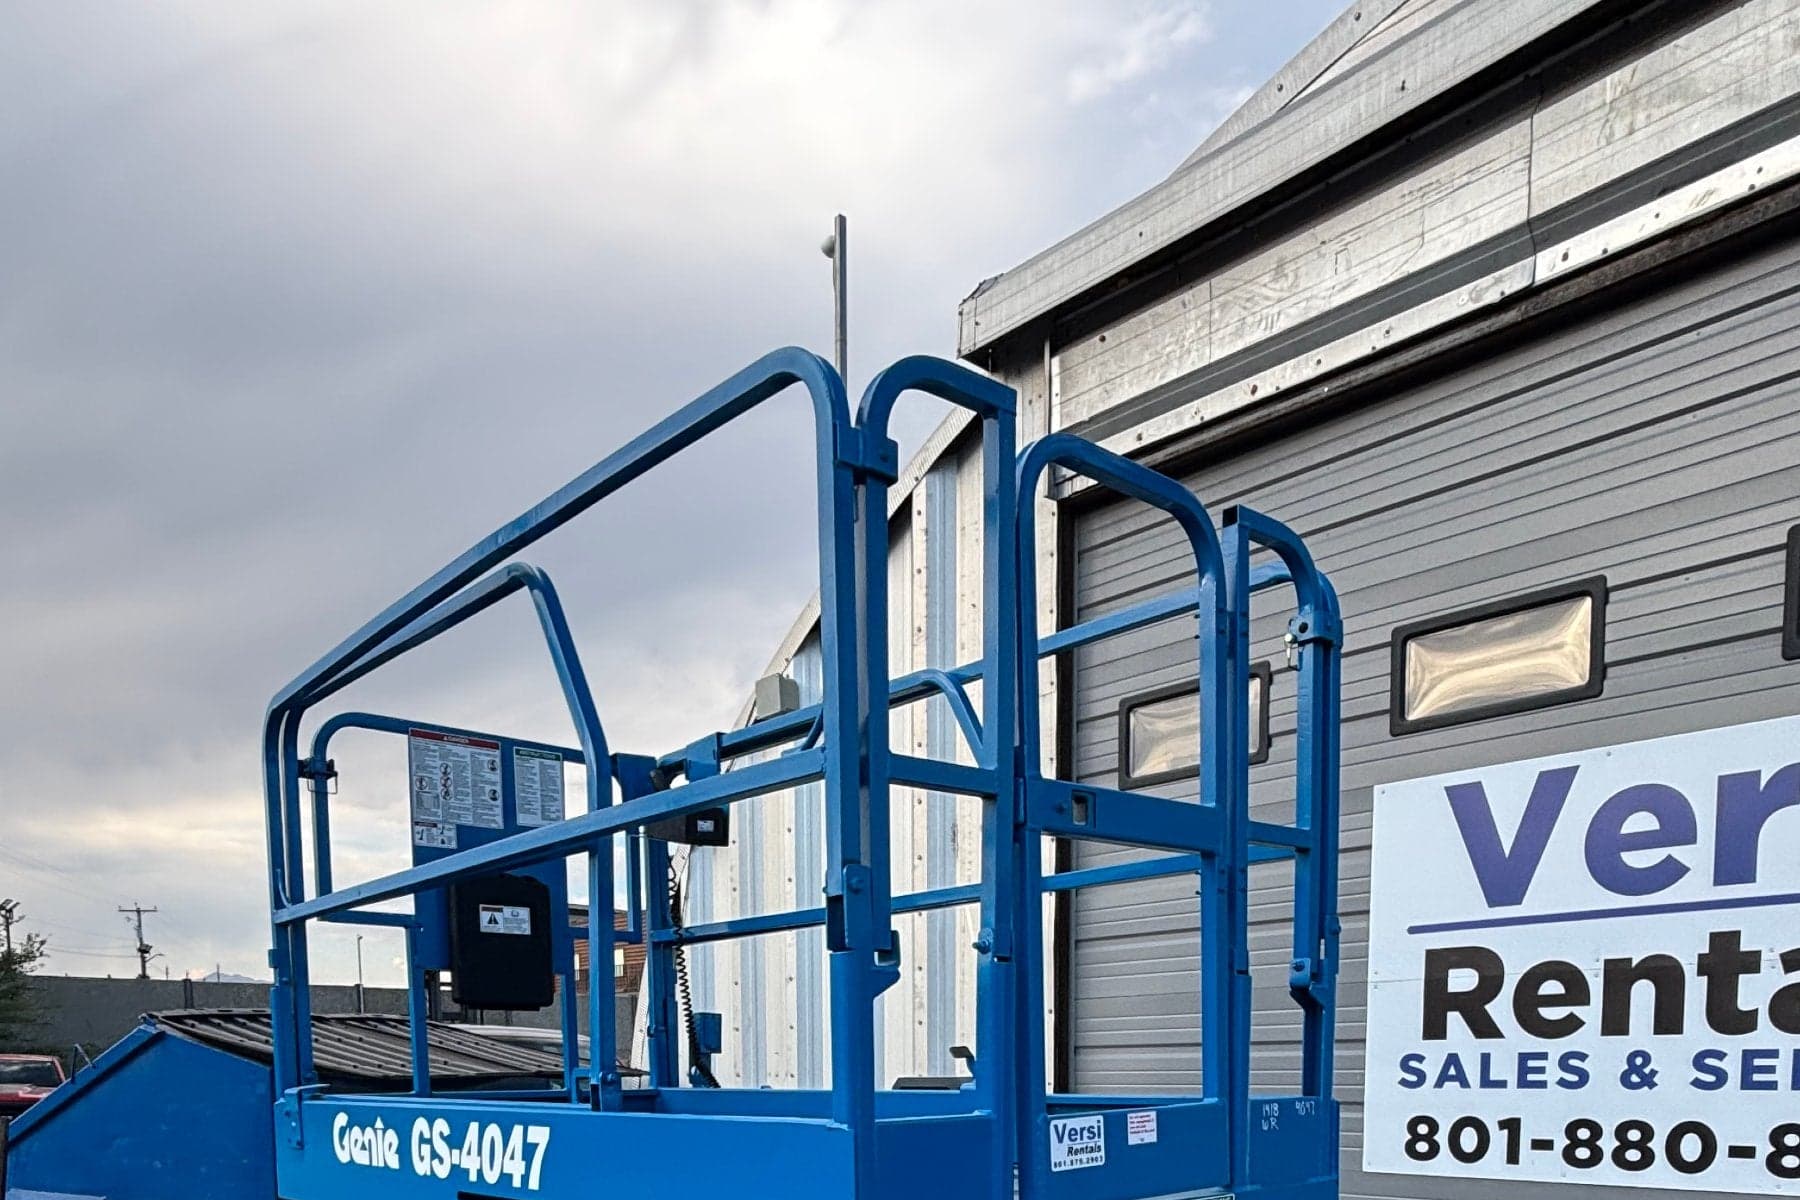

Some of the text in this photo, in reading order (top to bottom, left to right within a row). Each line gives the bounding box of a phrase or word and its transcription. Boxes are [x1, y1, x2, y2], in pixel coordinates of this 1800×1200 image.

[1444, 762, 1800, 908] Ver
[1398, 1048, 1800, 1091] SALES & SE
[333, 1112, 550, 1190] Genie GS-4047
[1053, 1120, 1101, 1144] Versi
[1067, 1144, 1102, 1157] Rentals
[1404, 1115, 1800, 1179] 801-880-8
